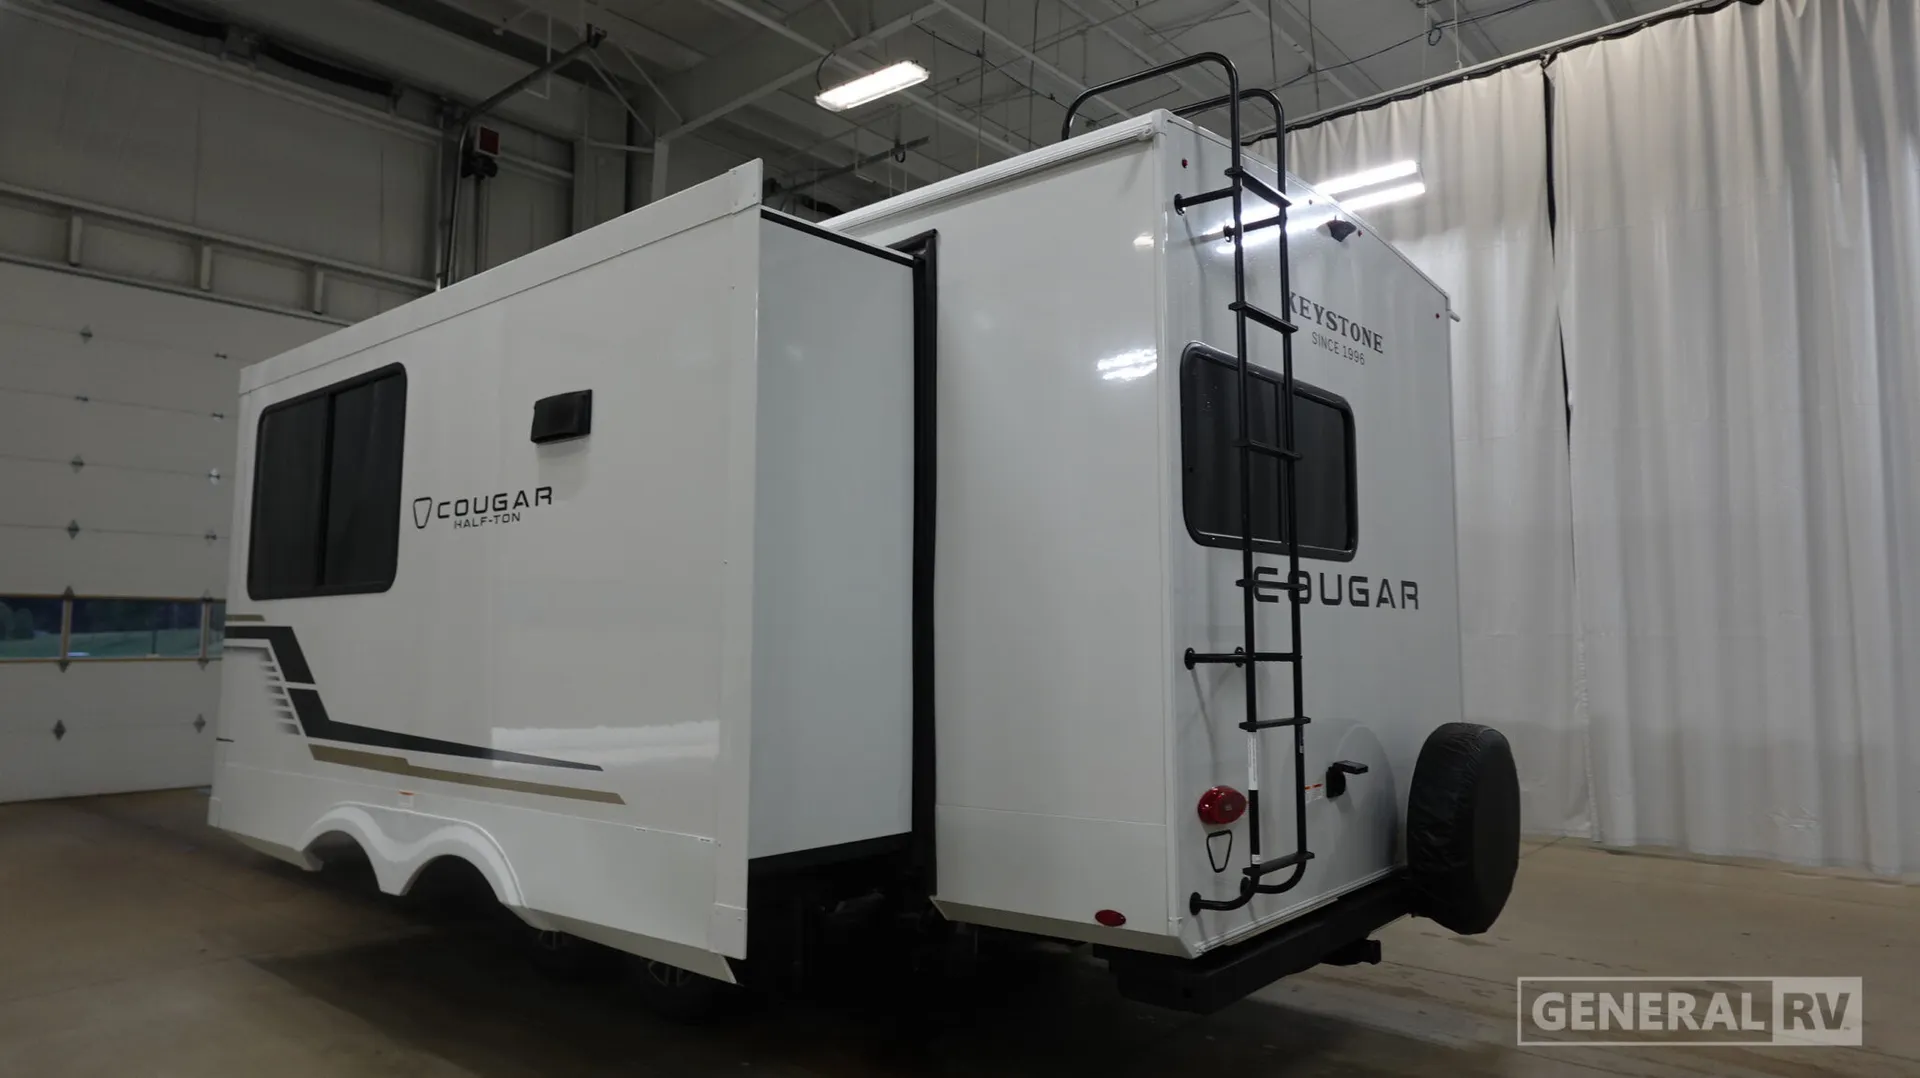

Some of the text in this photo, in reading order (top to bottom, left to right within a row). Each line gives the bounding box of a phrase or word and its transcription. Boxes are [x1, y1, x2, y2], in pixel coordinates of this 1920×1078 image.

[1288, 291, 1384, 354] KEYSTONE
[1311, 331, 1365, 365] SINCE 1996
[436, 486, 553, 519] COUGAR
[453, 512, 521, 529] HALF-TON
[1253, 566, 1419, 610] COUGAR
